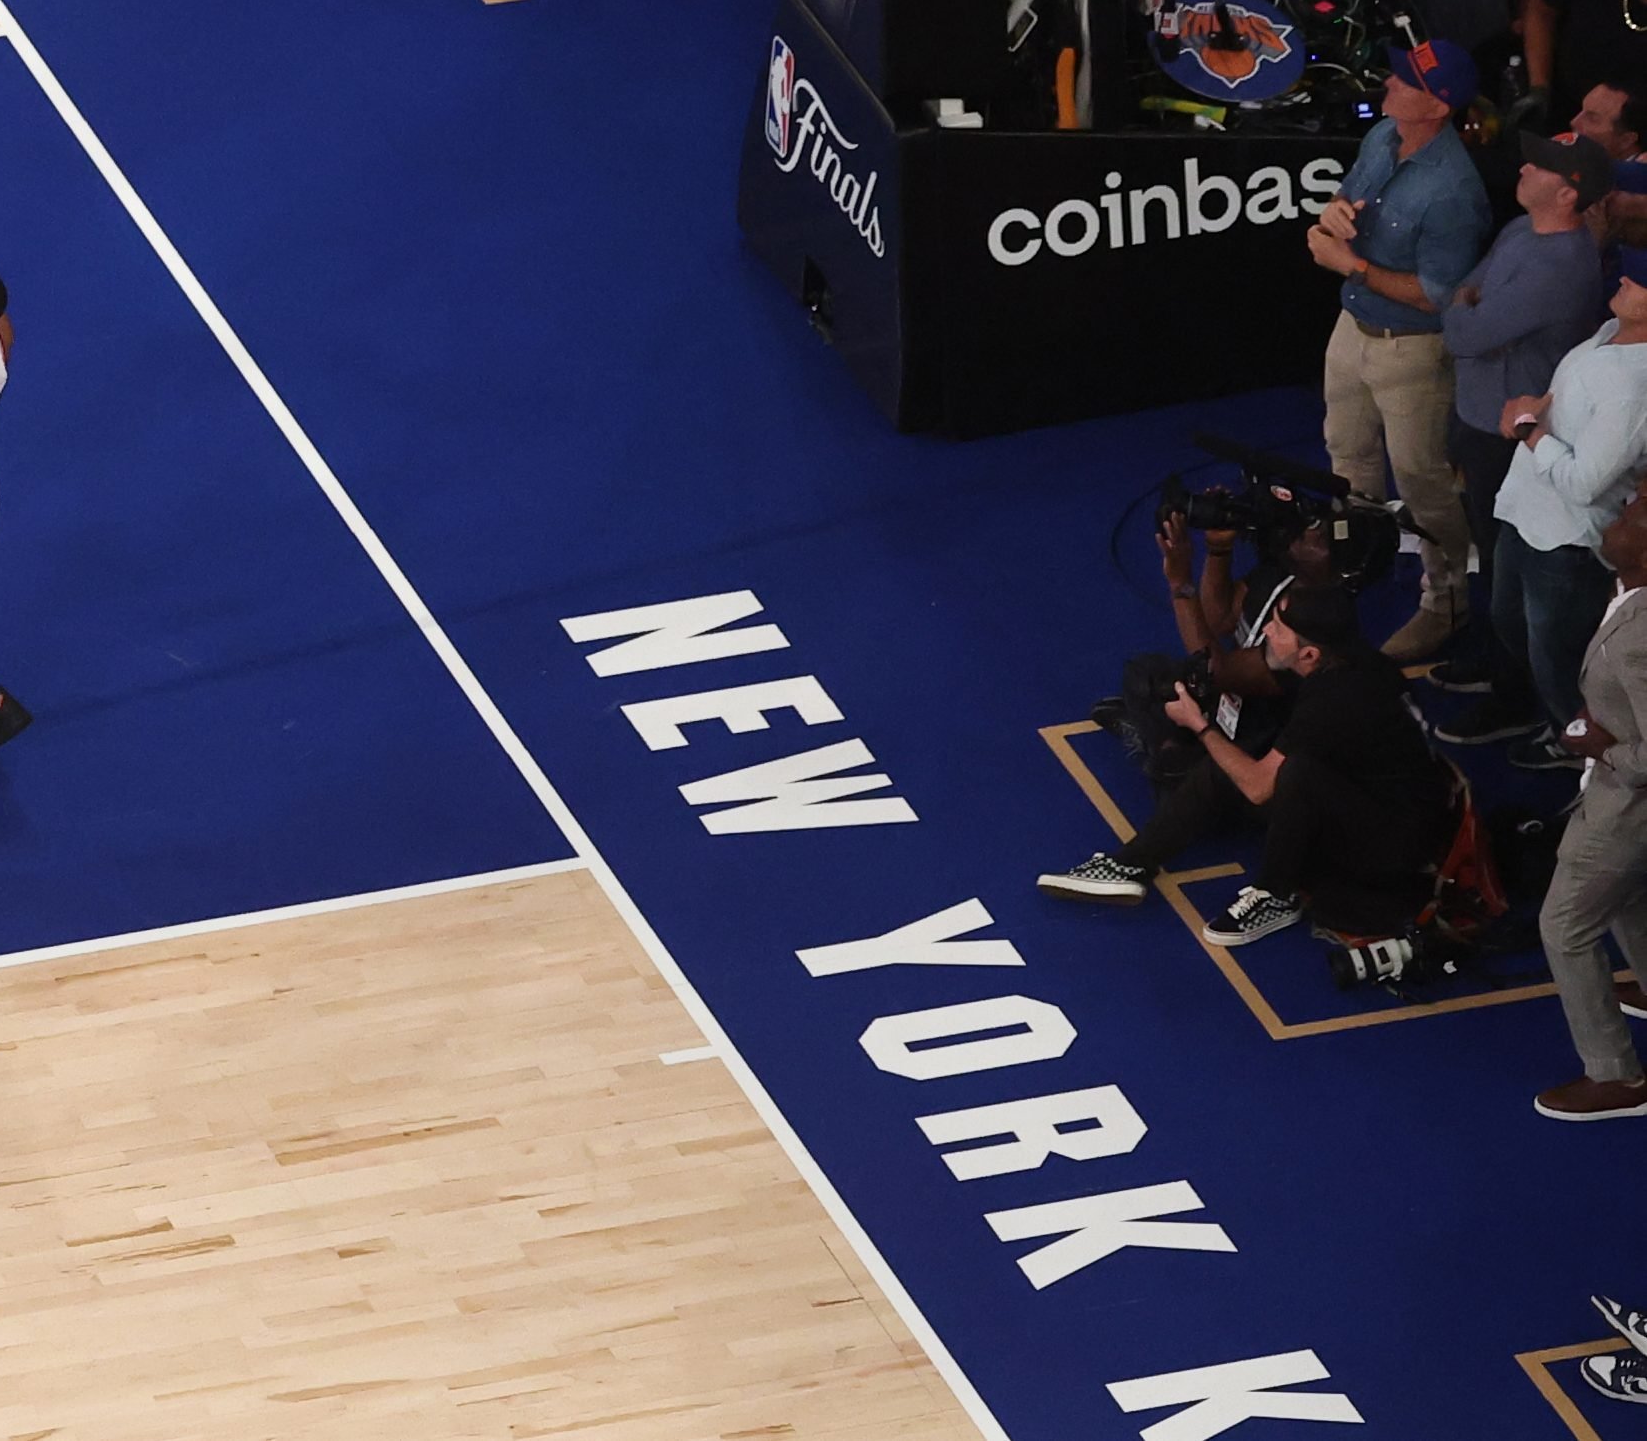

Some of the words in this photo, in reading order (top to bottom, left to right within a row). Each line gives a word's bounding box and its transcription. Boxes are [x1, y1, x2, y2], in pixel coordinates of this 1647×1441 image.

[773, 78, 886, 258] Finals
[987, 157, 1345, 267] coinbas
[559, 589, 920, 836] NEW
[795, 897, 1238, 1291] YORK
